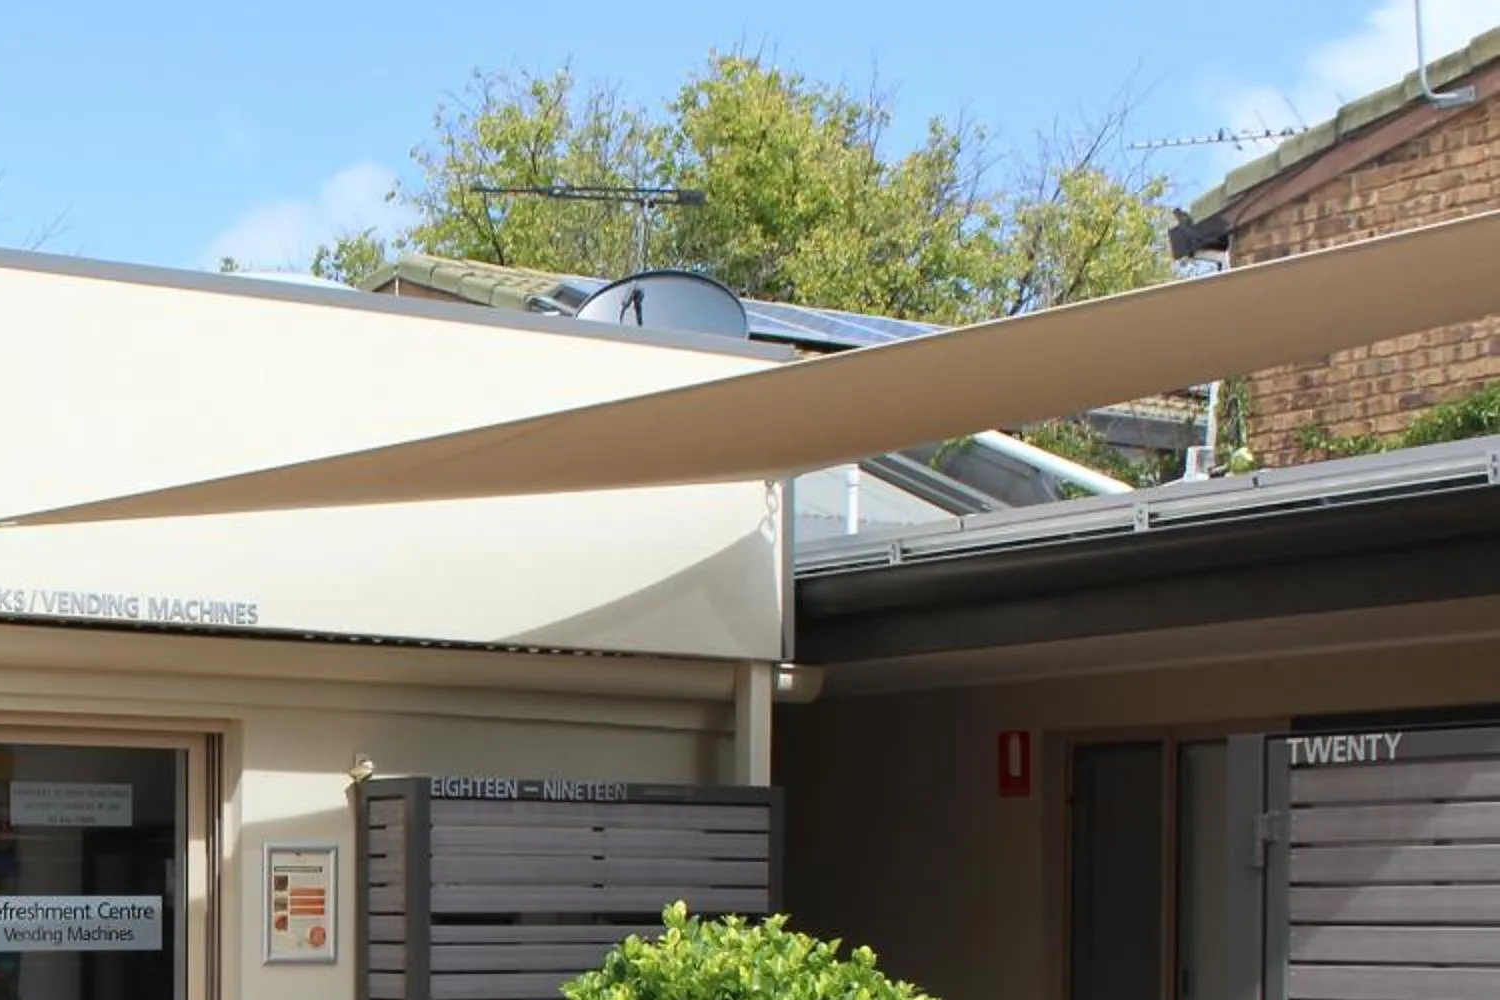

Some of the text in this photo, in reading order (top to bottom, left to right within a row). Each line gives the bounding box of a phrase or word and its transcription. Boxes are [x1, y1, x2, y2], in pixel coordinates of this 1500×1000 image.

[40, 590, 140, 619] VENDING
[147, 597, 259, 625] MACHINES
[1285, 732, 1402, 765] TWENTY
[430, 776, 518, 798] EIGHTEEN
[543, 780, 627, 801] NINETEEN
[97, 902, 156, 921] Centre
[4, 926, 135, 945] Vending Machines
